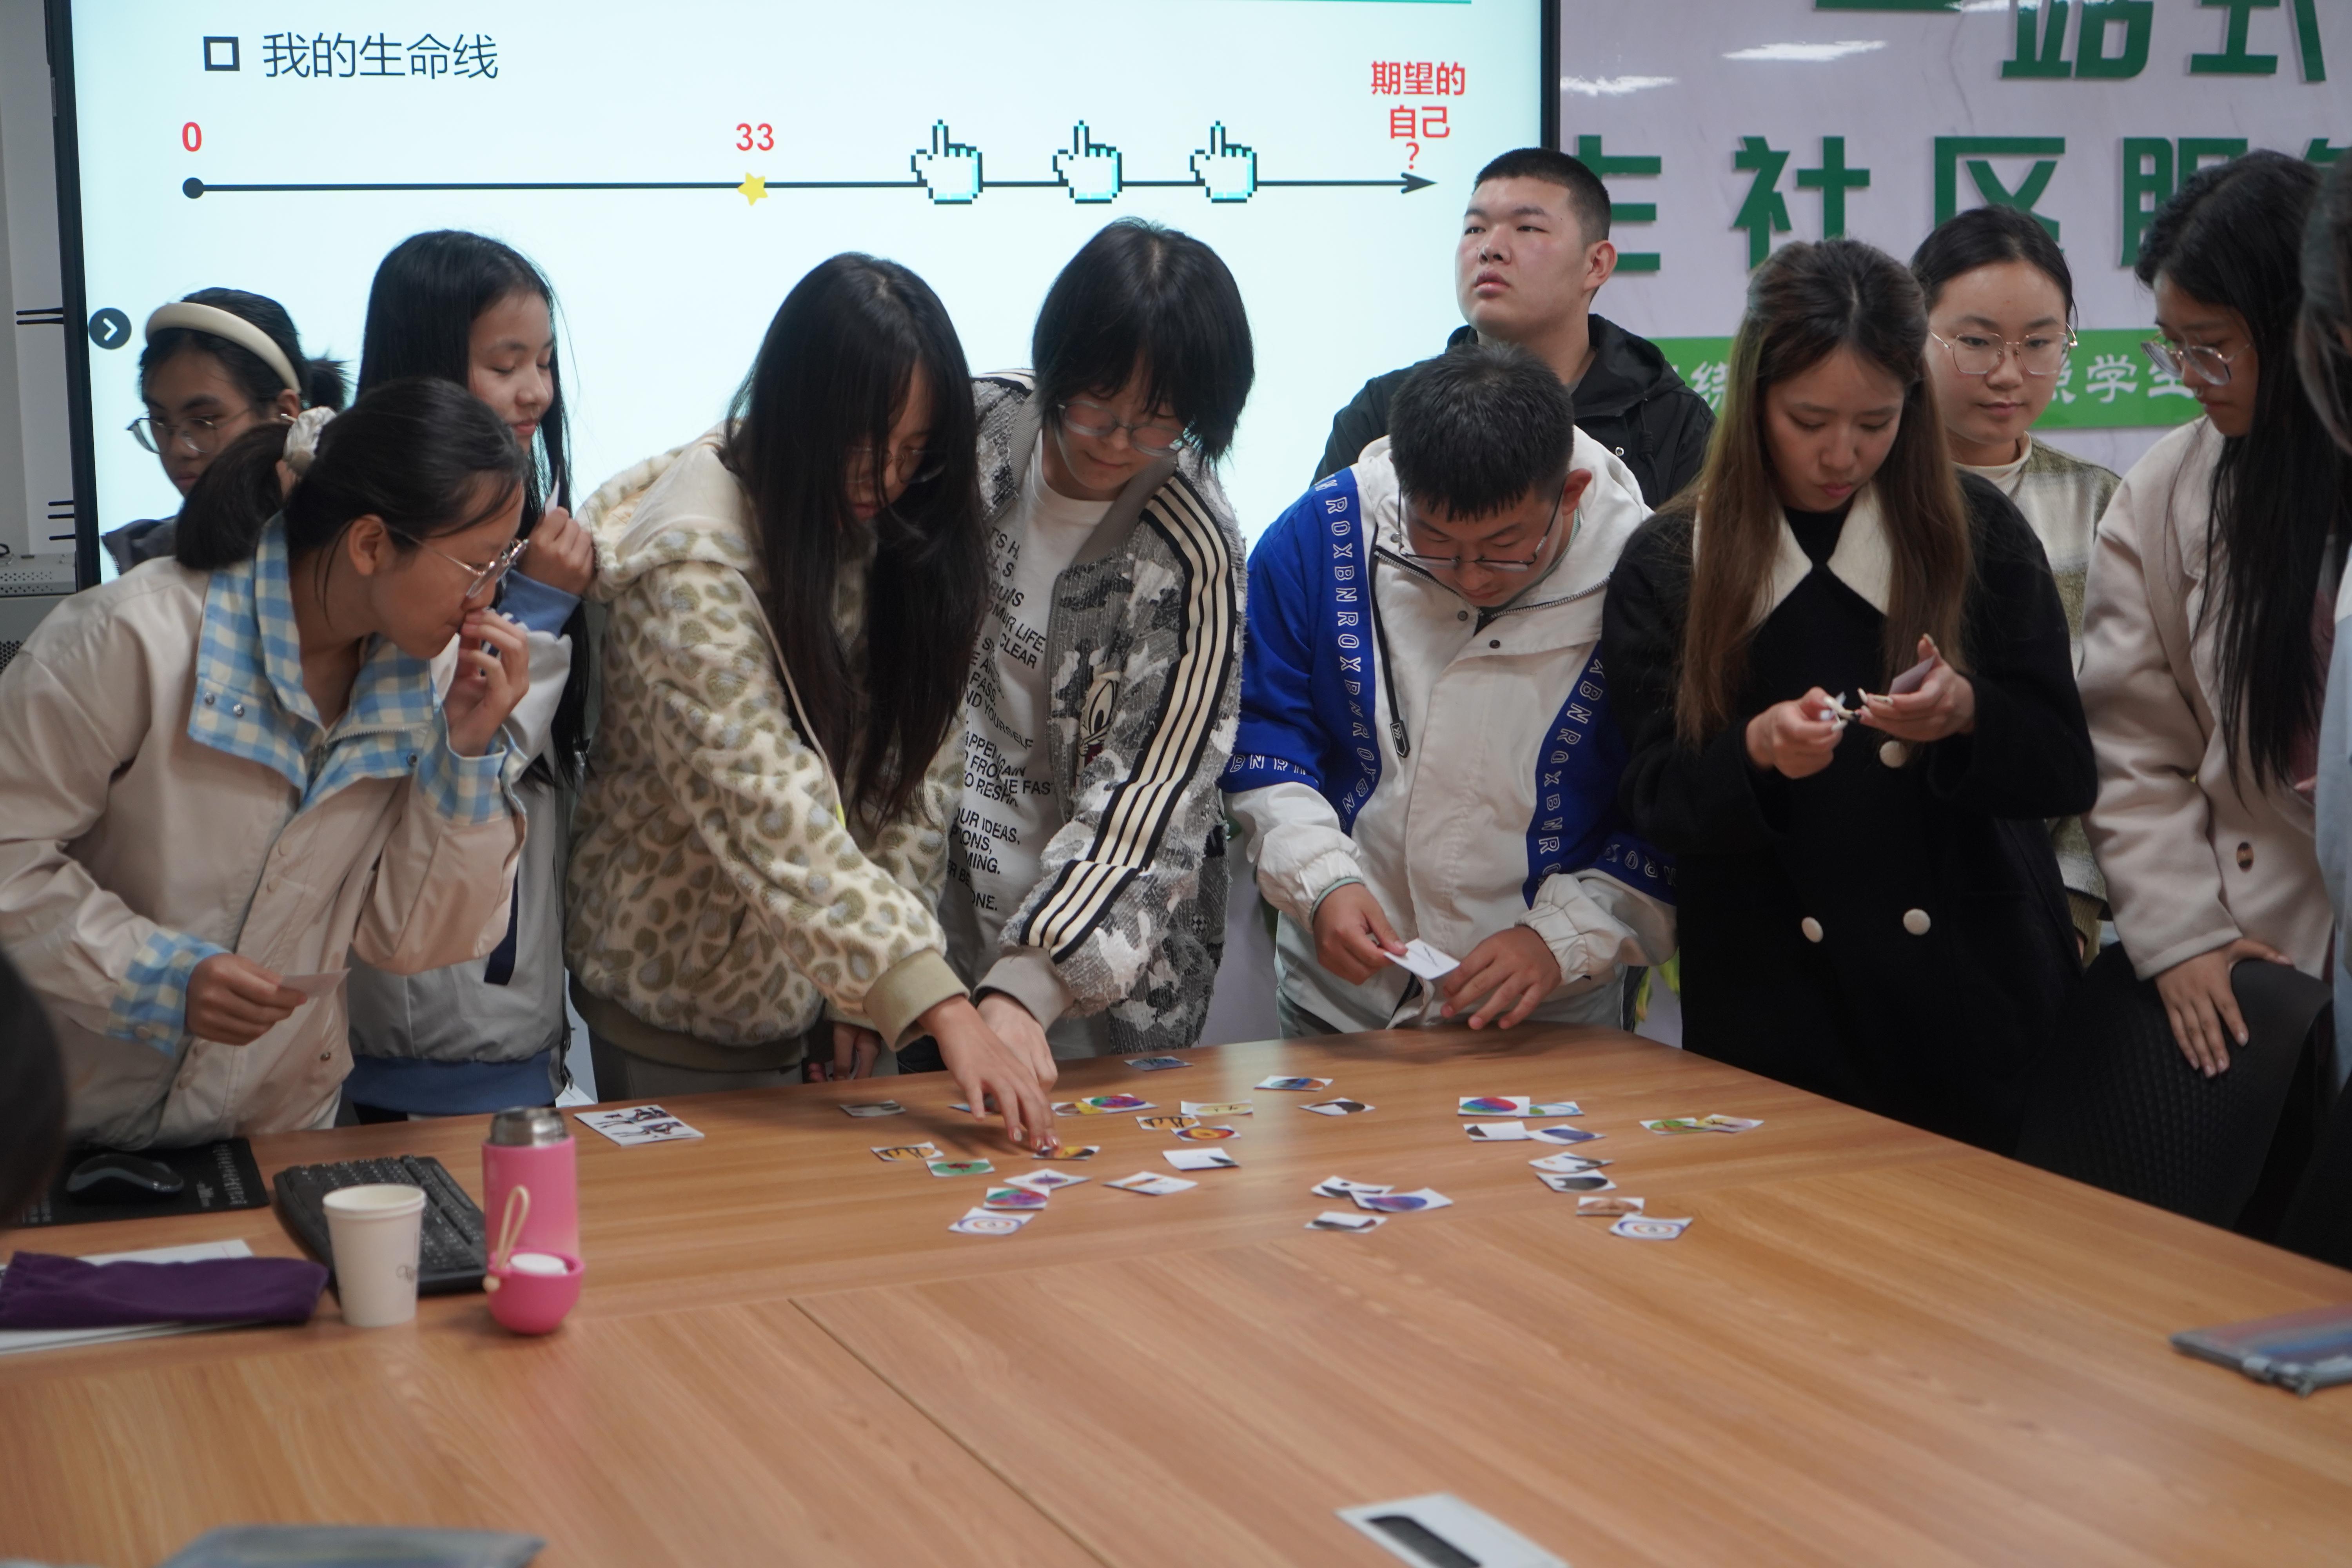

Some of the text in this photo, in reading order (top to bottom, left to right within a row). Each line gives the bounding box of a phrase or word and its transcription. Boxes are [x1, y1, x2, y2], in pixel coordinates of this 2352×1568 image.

[263, 32, 498, 80] 我的生命线
[1371, 61, 1465, 95] 期望的
[182, 122, 202, 152] 0
[736, 123, 774, 151] 33
[1390, 104, 1450, 139] 自己
[1406, 142, 1419, 169] ?
[1000, 633, 1037, 670] CLEAR
[981, 817, 1020, 846] IDEAS,
